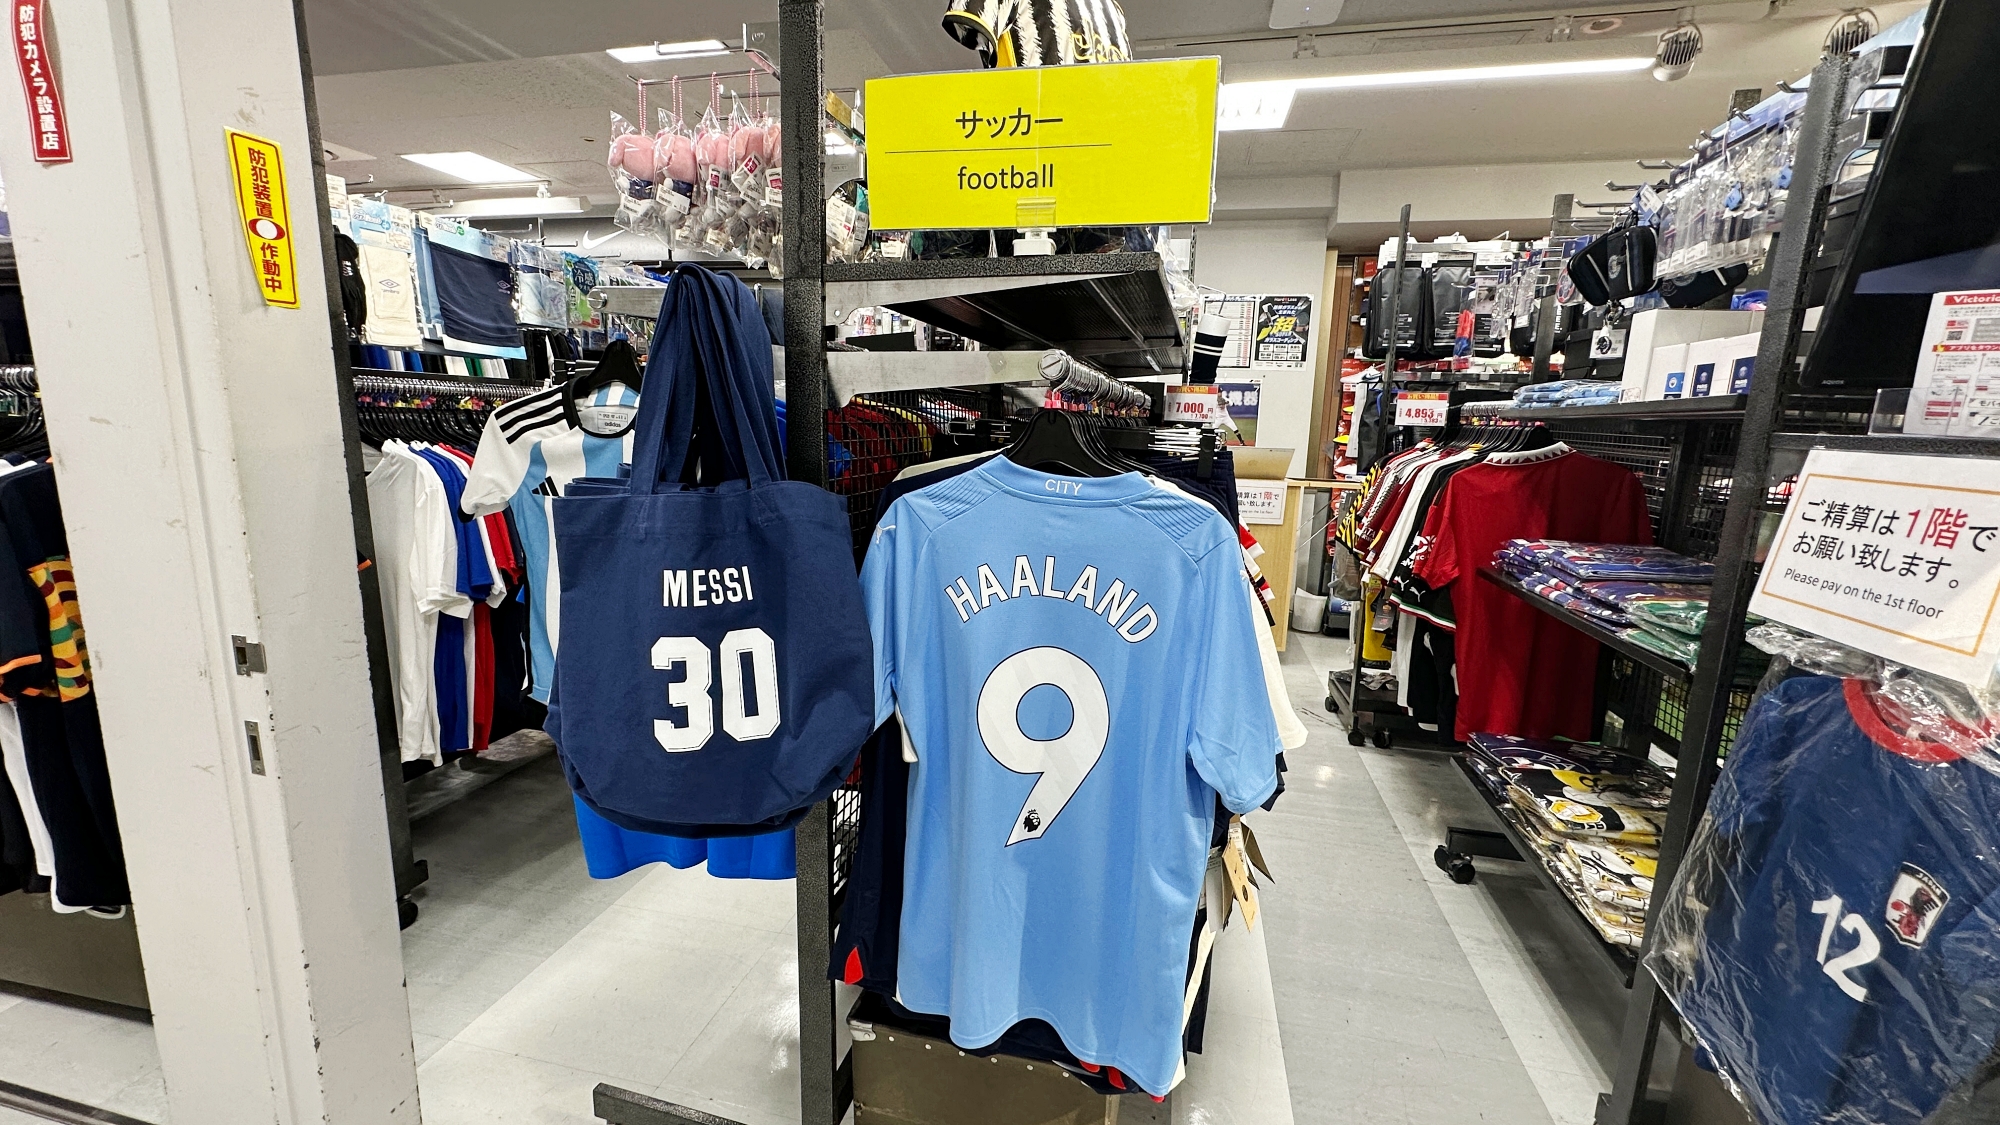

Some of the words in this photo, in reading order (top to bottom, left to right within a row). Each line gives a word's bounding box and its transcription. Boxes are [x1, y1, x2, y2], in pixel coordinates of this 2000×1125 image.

[19, 5, 59, 150] 防犯カメラ設置店
[955, 107, 1063, 139] サッカー
[248, 147, 274, 219] 防犯装置
[957, 163, 1054, 190] football
[260, 242, 282, 293] 作動中
[1176, 402, 1204, 414] 7,000
[1405, 408, 1434, 418] 4,893
[1045, 479, 1083, 496] CITY
[1802, 499, 1998, 552] ご精算は1階で
[1793, 531, 1959, 589] お願い致します。
[663, 566, 754, 607] MESSI
[945, 555, 1159, 643] HAALAND
[1784, 568, 1819, 586] Please
[1820, 579, 1842, 595] pay
[1843, 585, 1859, 597] on
[1862, 588, 1882, 604] the
[1884, 593, 1905, 610] 1st
[1907, 598, 1944, 619] floor
[651, 627, 781, 753] 30
[977, 646, 1110, 848] 9
[1812, 894, 1881, 1003] 12
